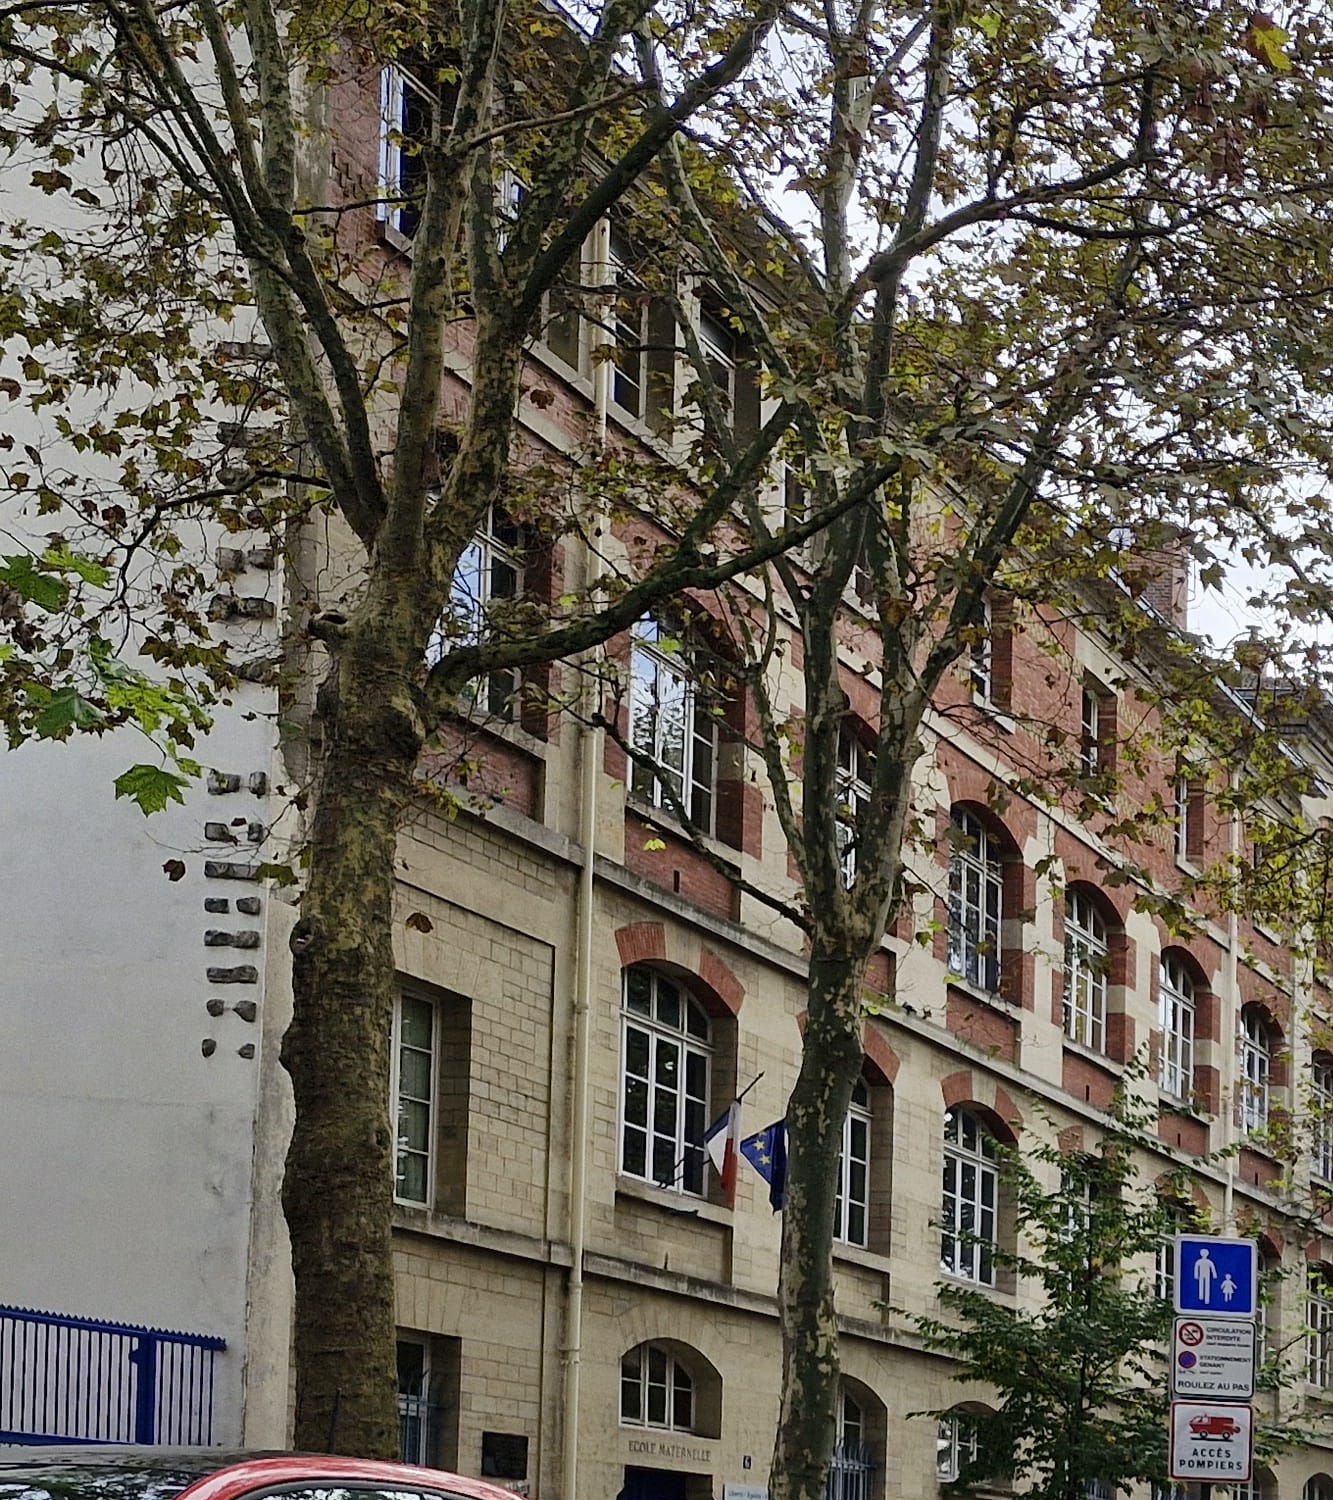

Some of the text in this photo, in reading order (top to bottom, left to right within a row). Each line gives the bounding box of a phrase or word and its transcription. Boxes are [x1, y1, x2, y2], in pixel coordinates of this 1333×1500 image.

[1177, 1381, 1250, 1392] ROULEZ AU PAS
[628, 1440, 712, 1462] ECOLE MATERNELLE
[1178, 1459, 1243, 1471] POMPIERS
